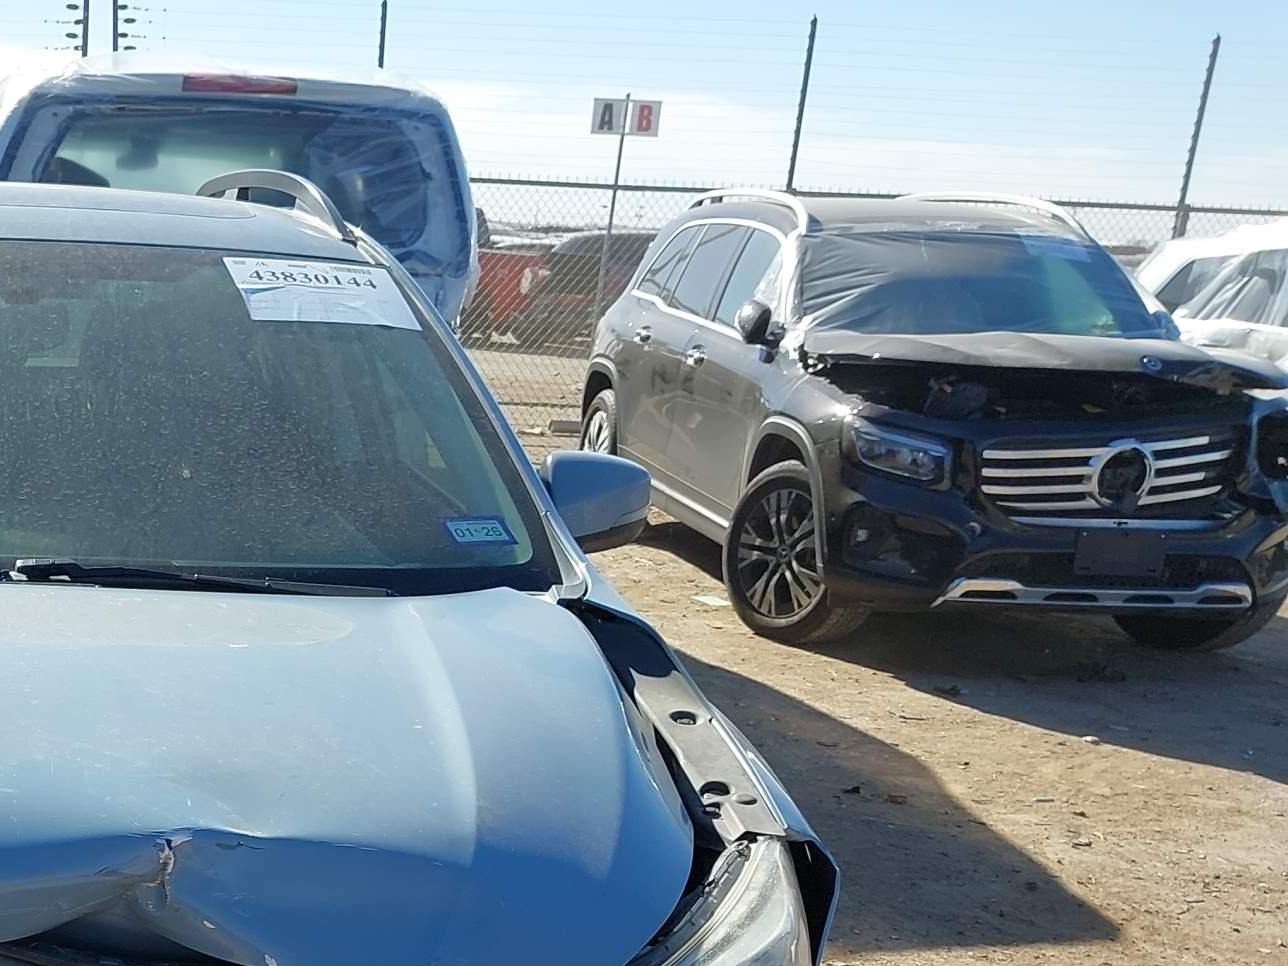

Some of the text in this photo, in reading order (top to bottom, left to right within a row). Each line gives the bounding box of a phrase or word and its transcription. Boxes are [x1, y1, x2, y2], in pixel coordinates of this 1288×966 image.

[598, 103, 653, 132] A B
[248, 269, 378, 290] 43830144
